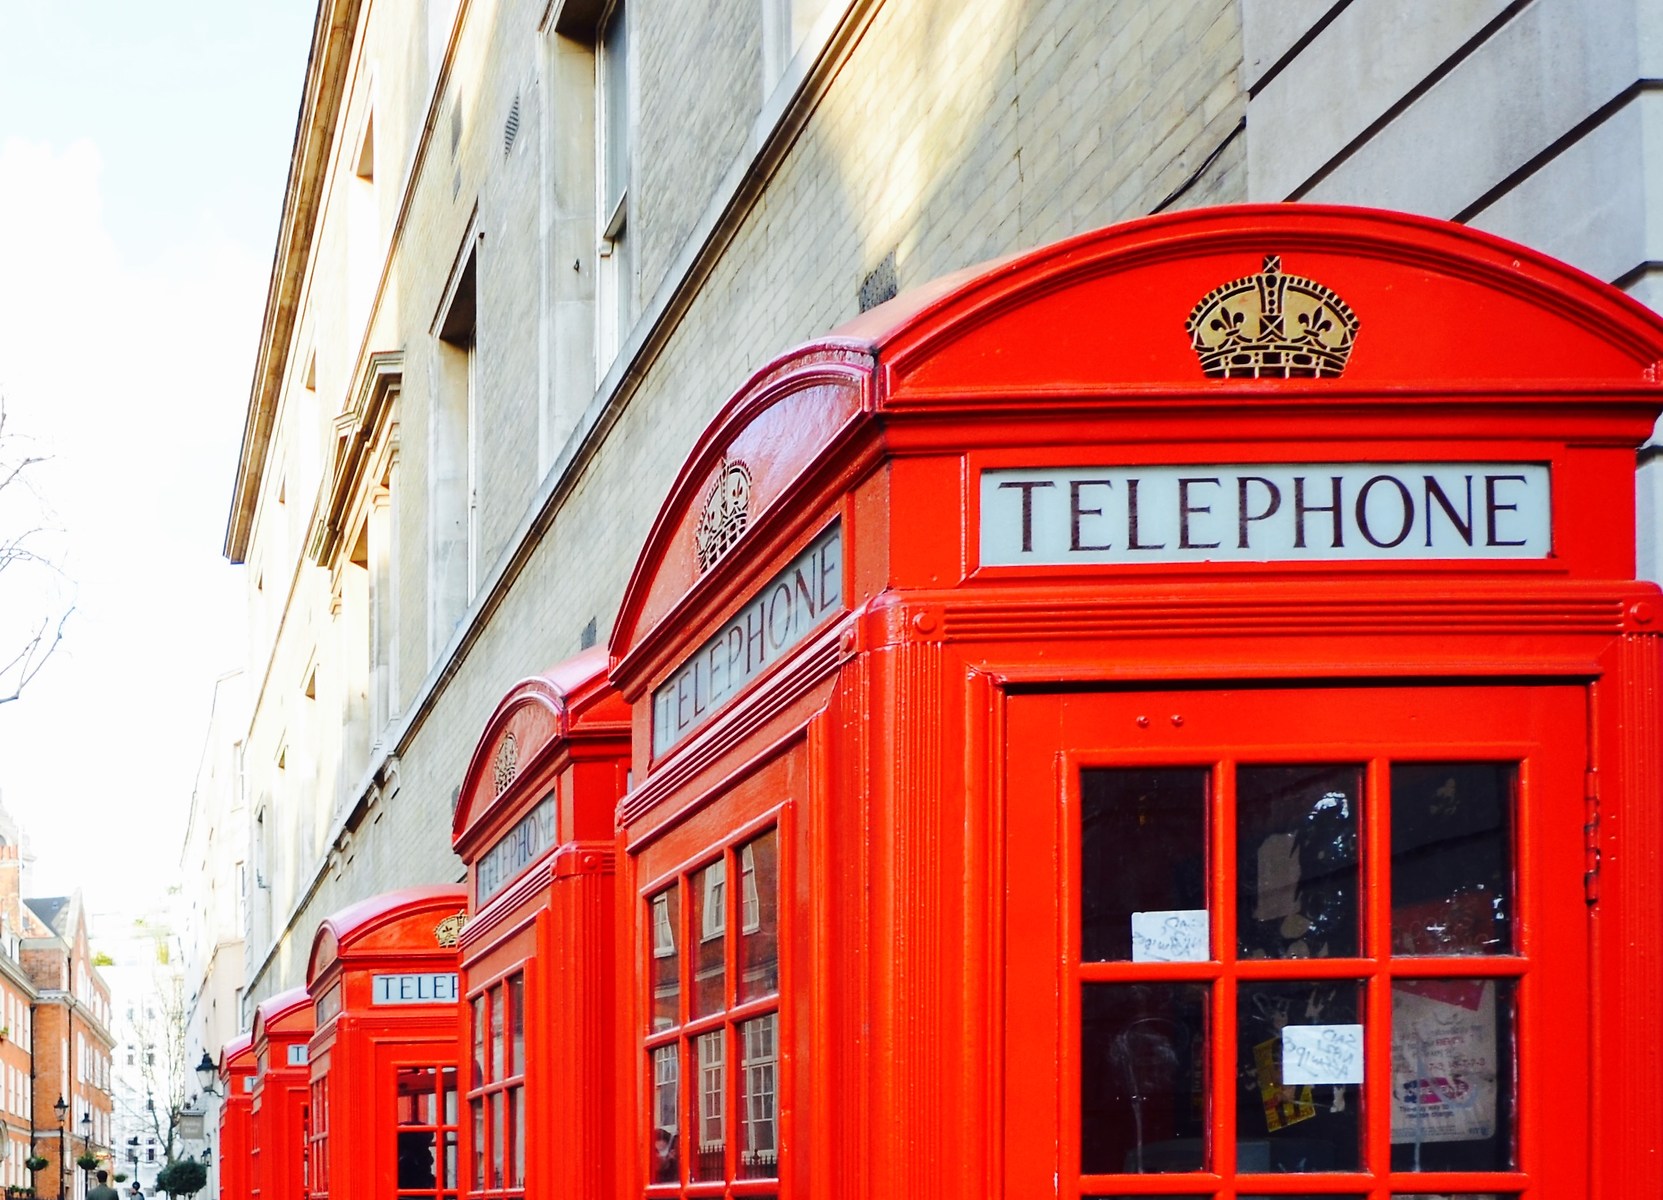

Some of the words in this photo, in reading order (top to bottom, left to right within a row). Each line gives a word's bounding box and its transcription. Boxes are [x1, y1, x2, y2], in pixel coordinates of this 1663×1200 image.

[997, 473, 1528, 554] TELEPHONE
[655, 535, 840, 742] TELEPHONE
[479, 797, 556, 898] TELEPHONE
[292, 1046, 304, 1062] T
